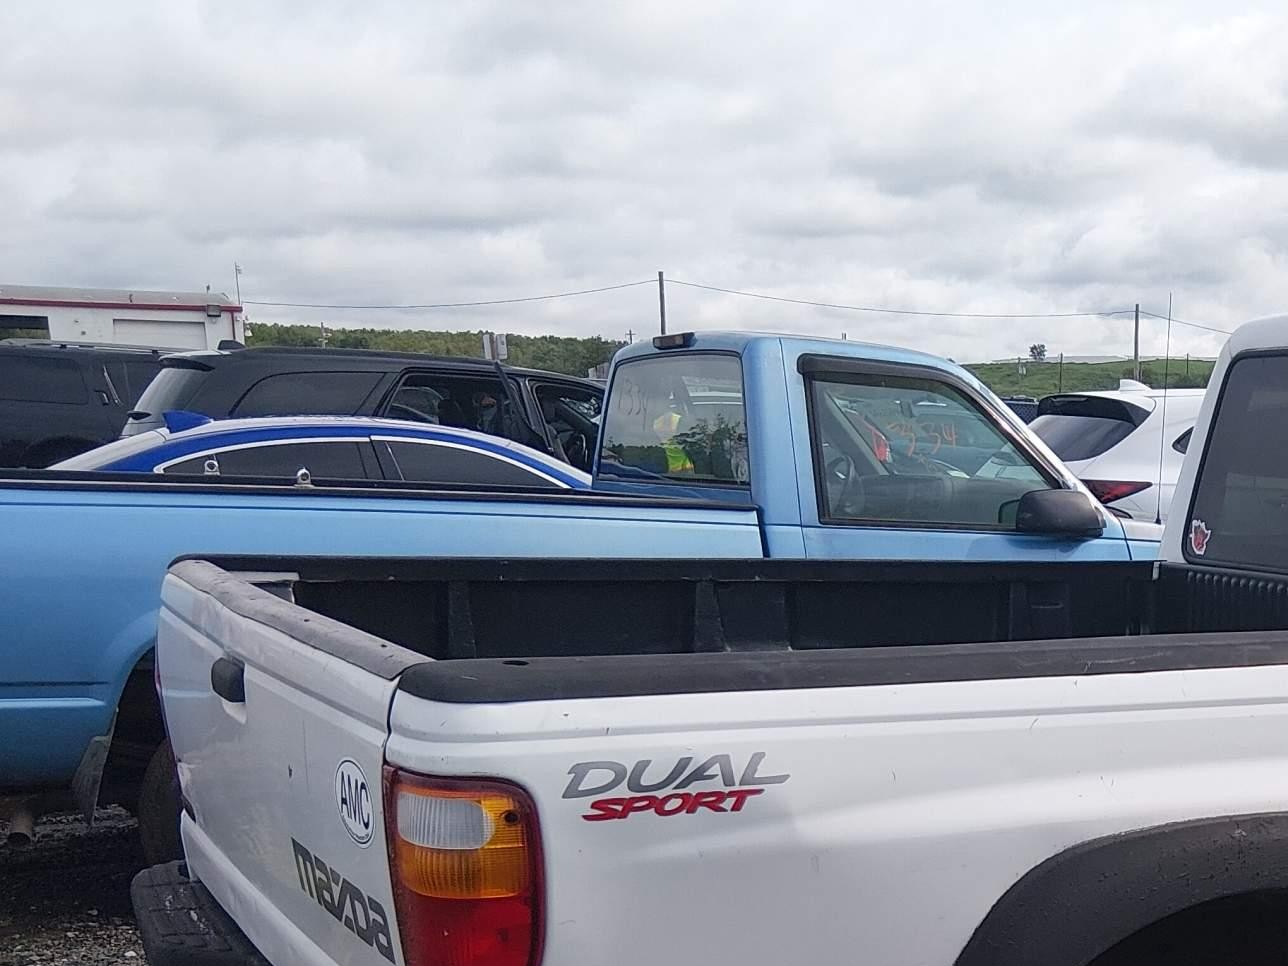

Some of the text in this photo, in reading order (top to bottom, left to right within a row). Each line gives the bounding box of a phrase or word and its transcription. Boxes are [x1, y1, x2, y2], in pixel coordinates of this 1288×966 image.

[562, 751, 791, 799] DUAL
[341, 770, 371, 831] AMC
[581, 788, 765, 822] SPORT
